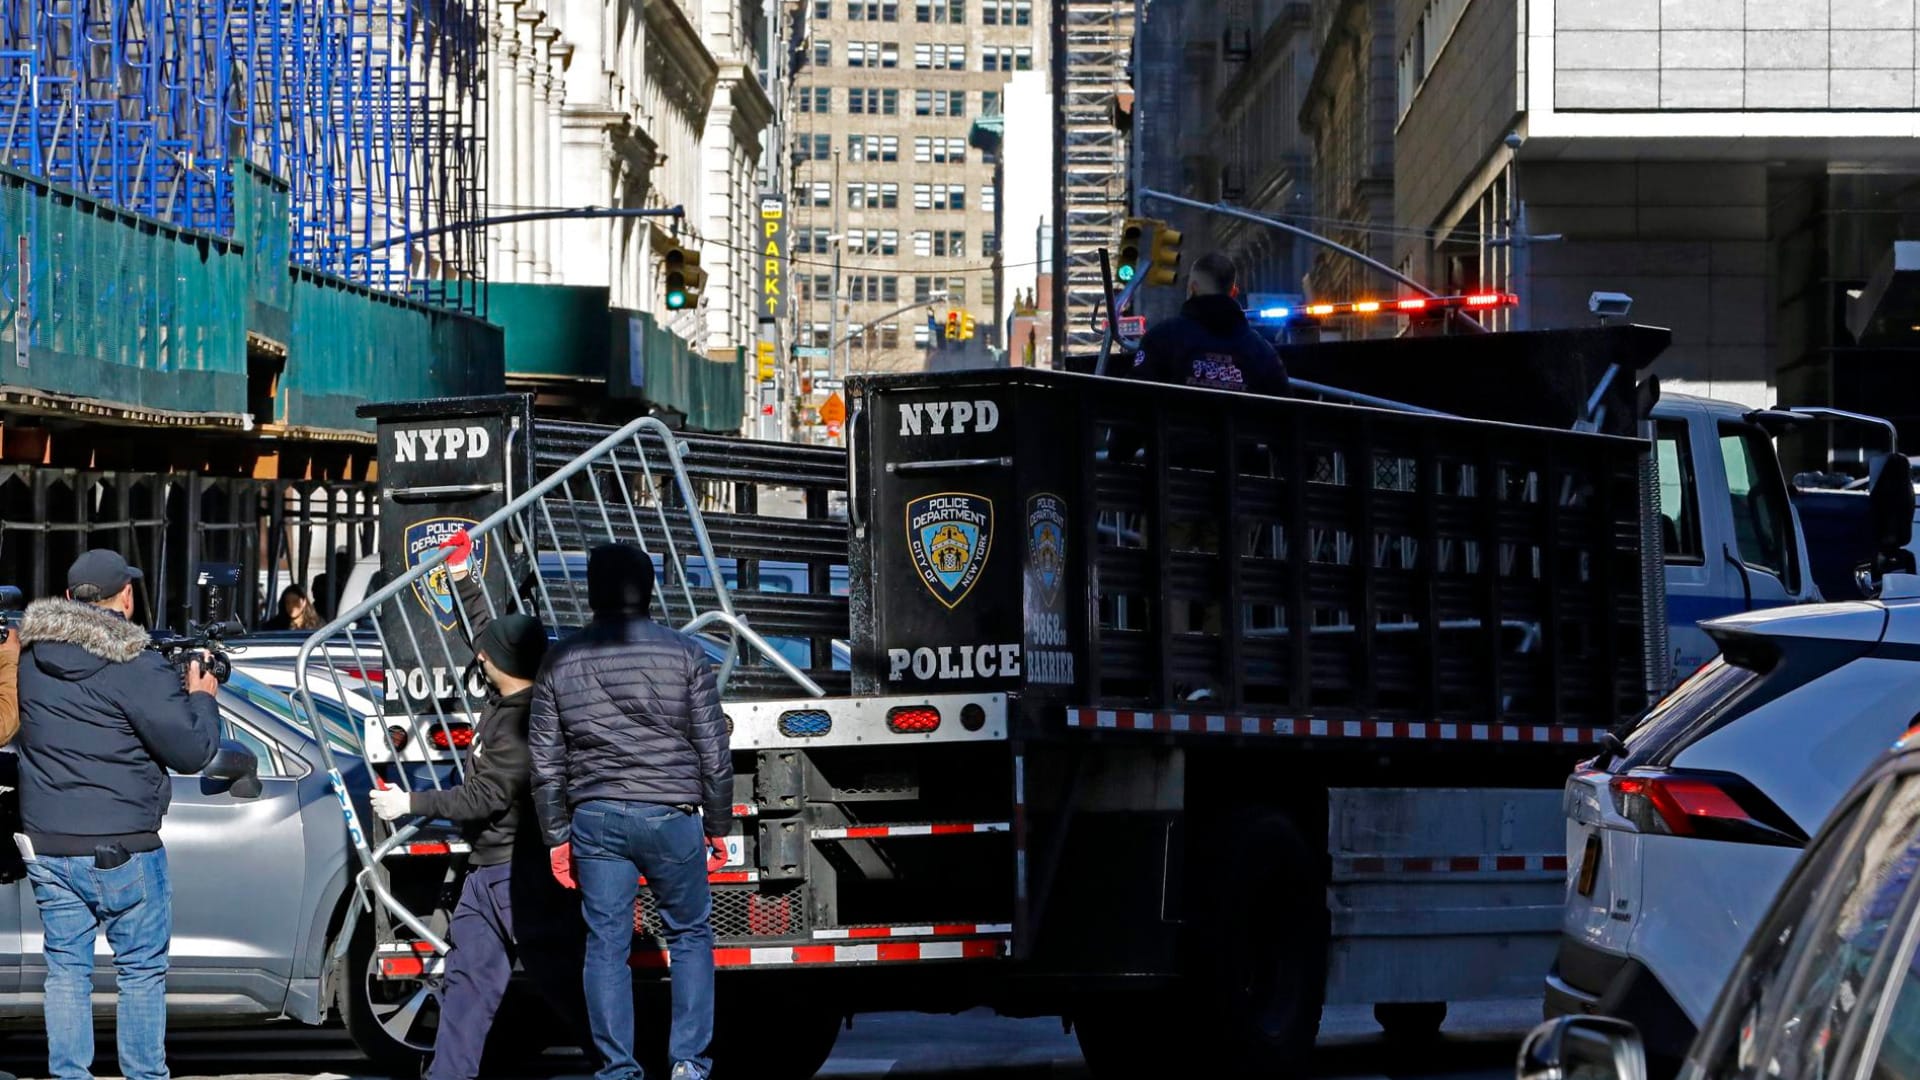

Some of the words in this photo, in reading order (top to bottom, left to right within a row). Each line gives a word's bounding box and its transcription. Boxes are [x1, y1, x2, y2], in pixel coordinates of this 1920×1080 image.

[765, 222, 780, 295] PARK
[900, 400, 999, 436] NYPD
[395, 426, 490, 462] NYPD
[913, 509, 986, 529] DEPARTMENT
[929, 498, 969, 511] POLICE
[913, 541, 928, 567] CITY
[924, 570, 938, 584] OF
[962, 563, 978, 587] NEW
[974, 534, 987, 561] YORK
[888, 644, 1020, 681] POLICE
[1027, 651, 1075, 685] BARRIER
[385, 666, 487, 700] POLIC
[328, 771, 362, 844] NYPD
